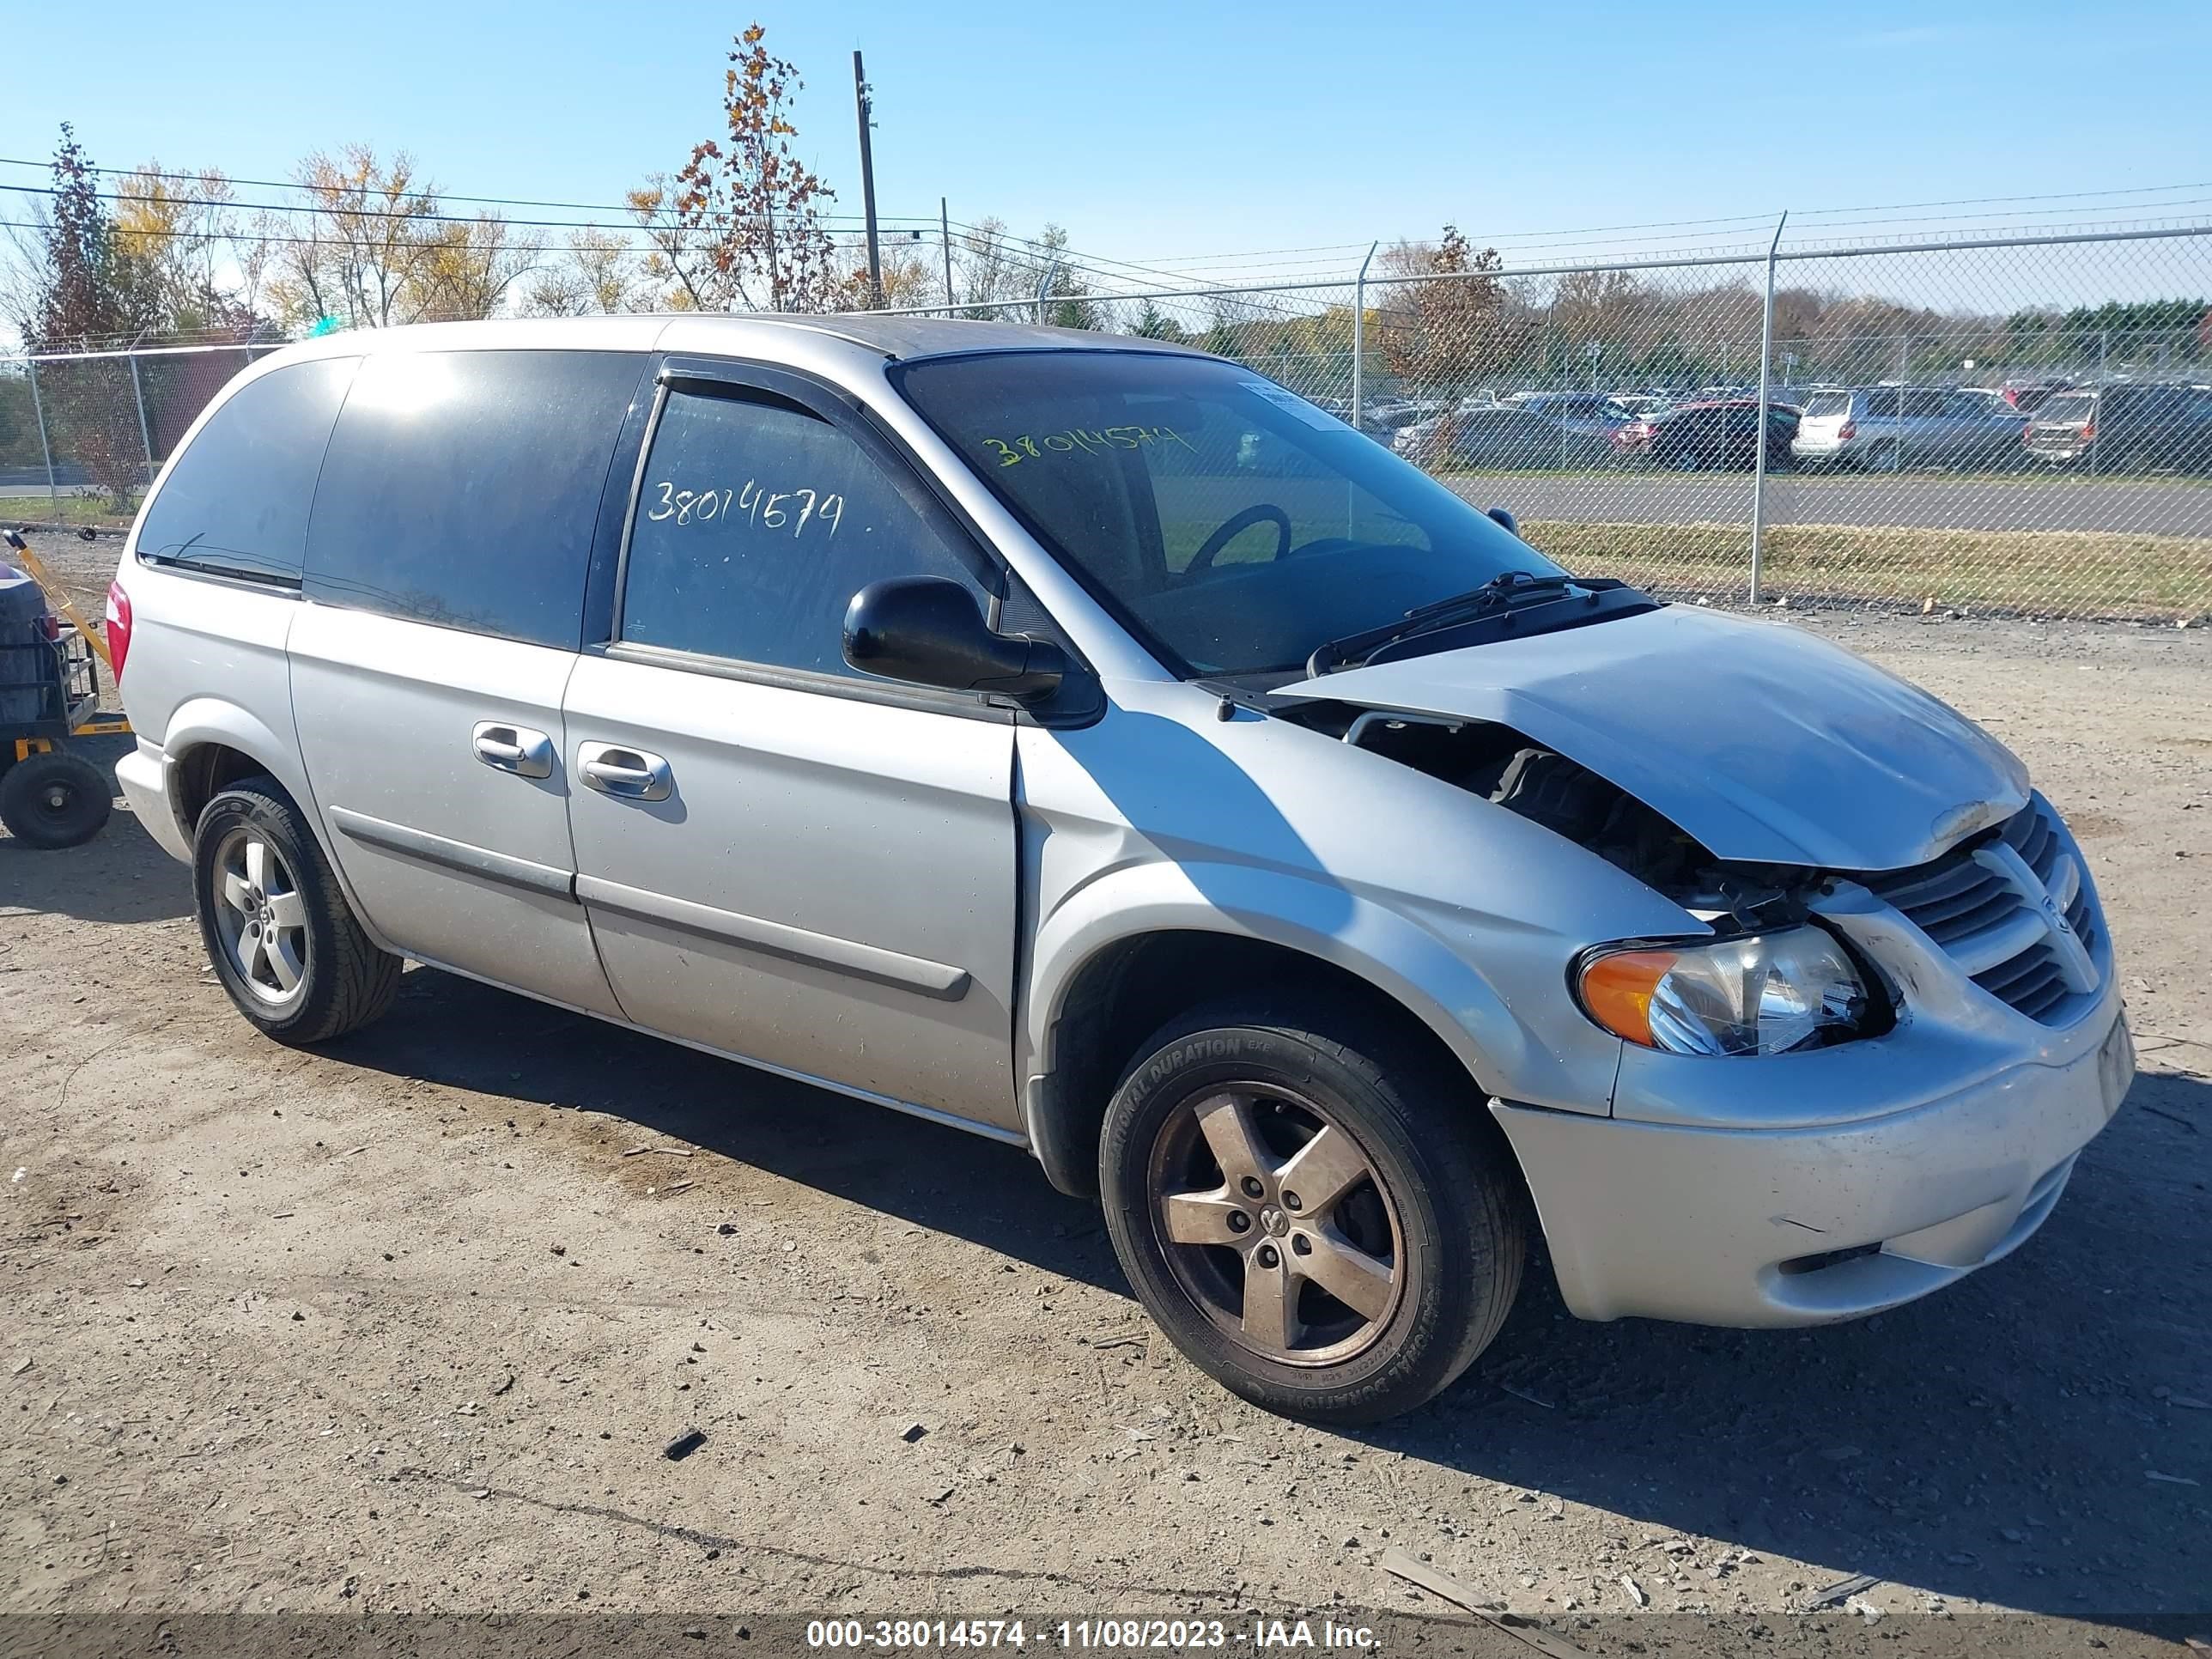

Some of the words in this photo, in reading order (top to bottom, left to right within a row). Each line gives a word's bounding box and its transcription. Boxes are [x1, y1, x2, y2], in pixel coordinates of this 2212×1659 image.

[982, 426, 1202, 467] 38014574
[648, 477, 846, 540] 38014574
[1151, 1037, 1241, 1084] DURATION
